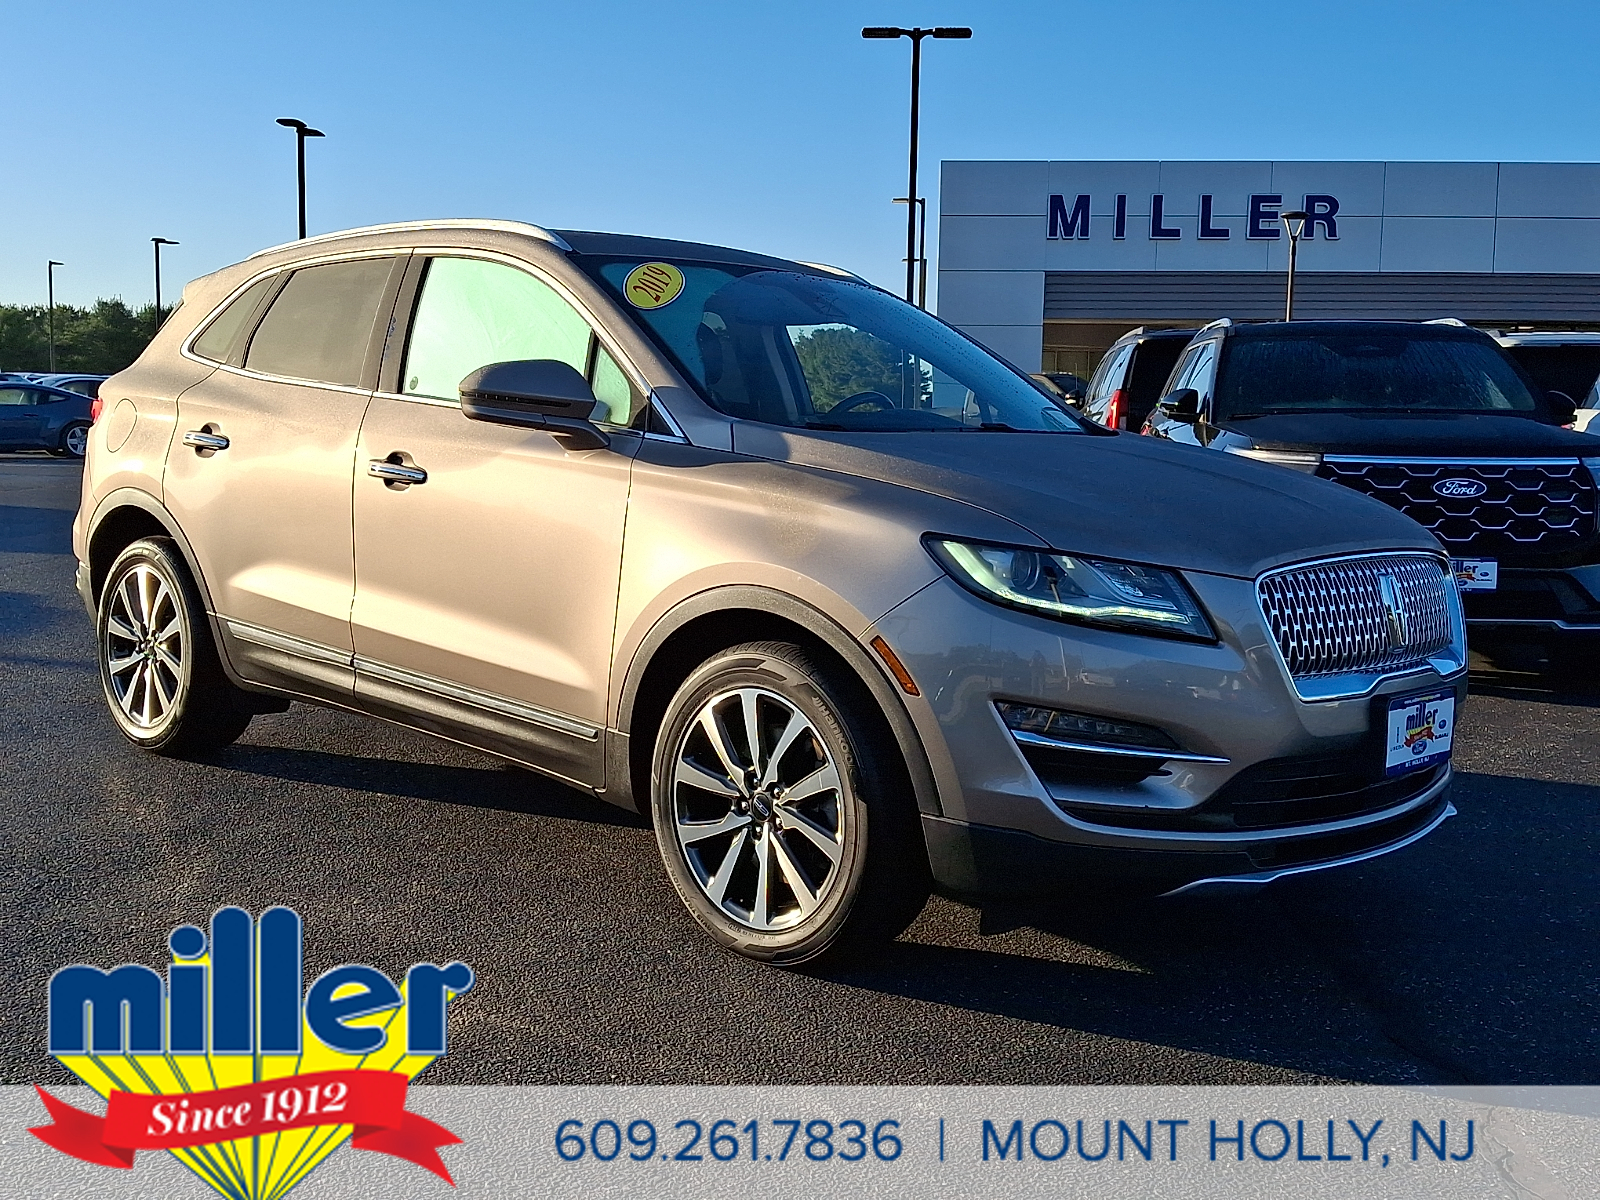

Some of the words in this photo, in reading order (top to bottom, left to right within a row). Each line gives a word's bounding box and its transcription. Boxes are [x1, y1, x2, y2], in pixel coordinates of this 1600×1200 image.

[1046, 193, 1340, 240] MILLER
[633, 265, 672, 303] 2019
[1442, 480, 1477, 495] Ford
[1452, 560, 1479, 573] iller
[1406, 702, 1438, 730] miller
